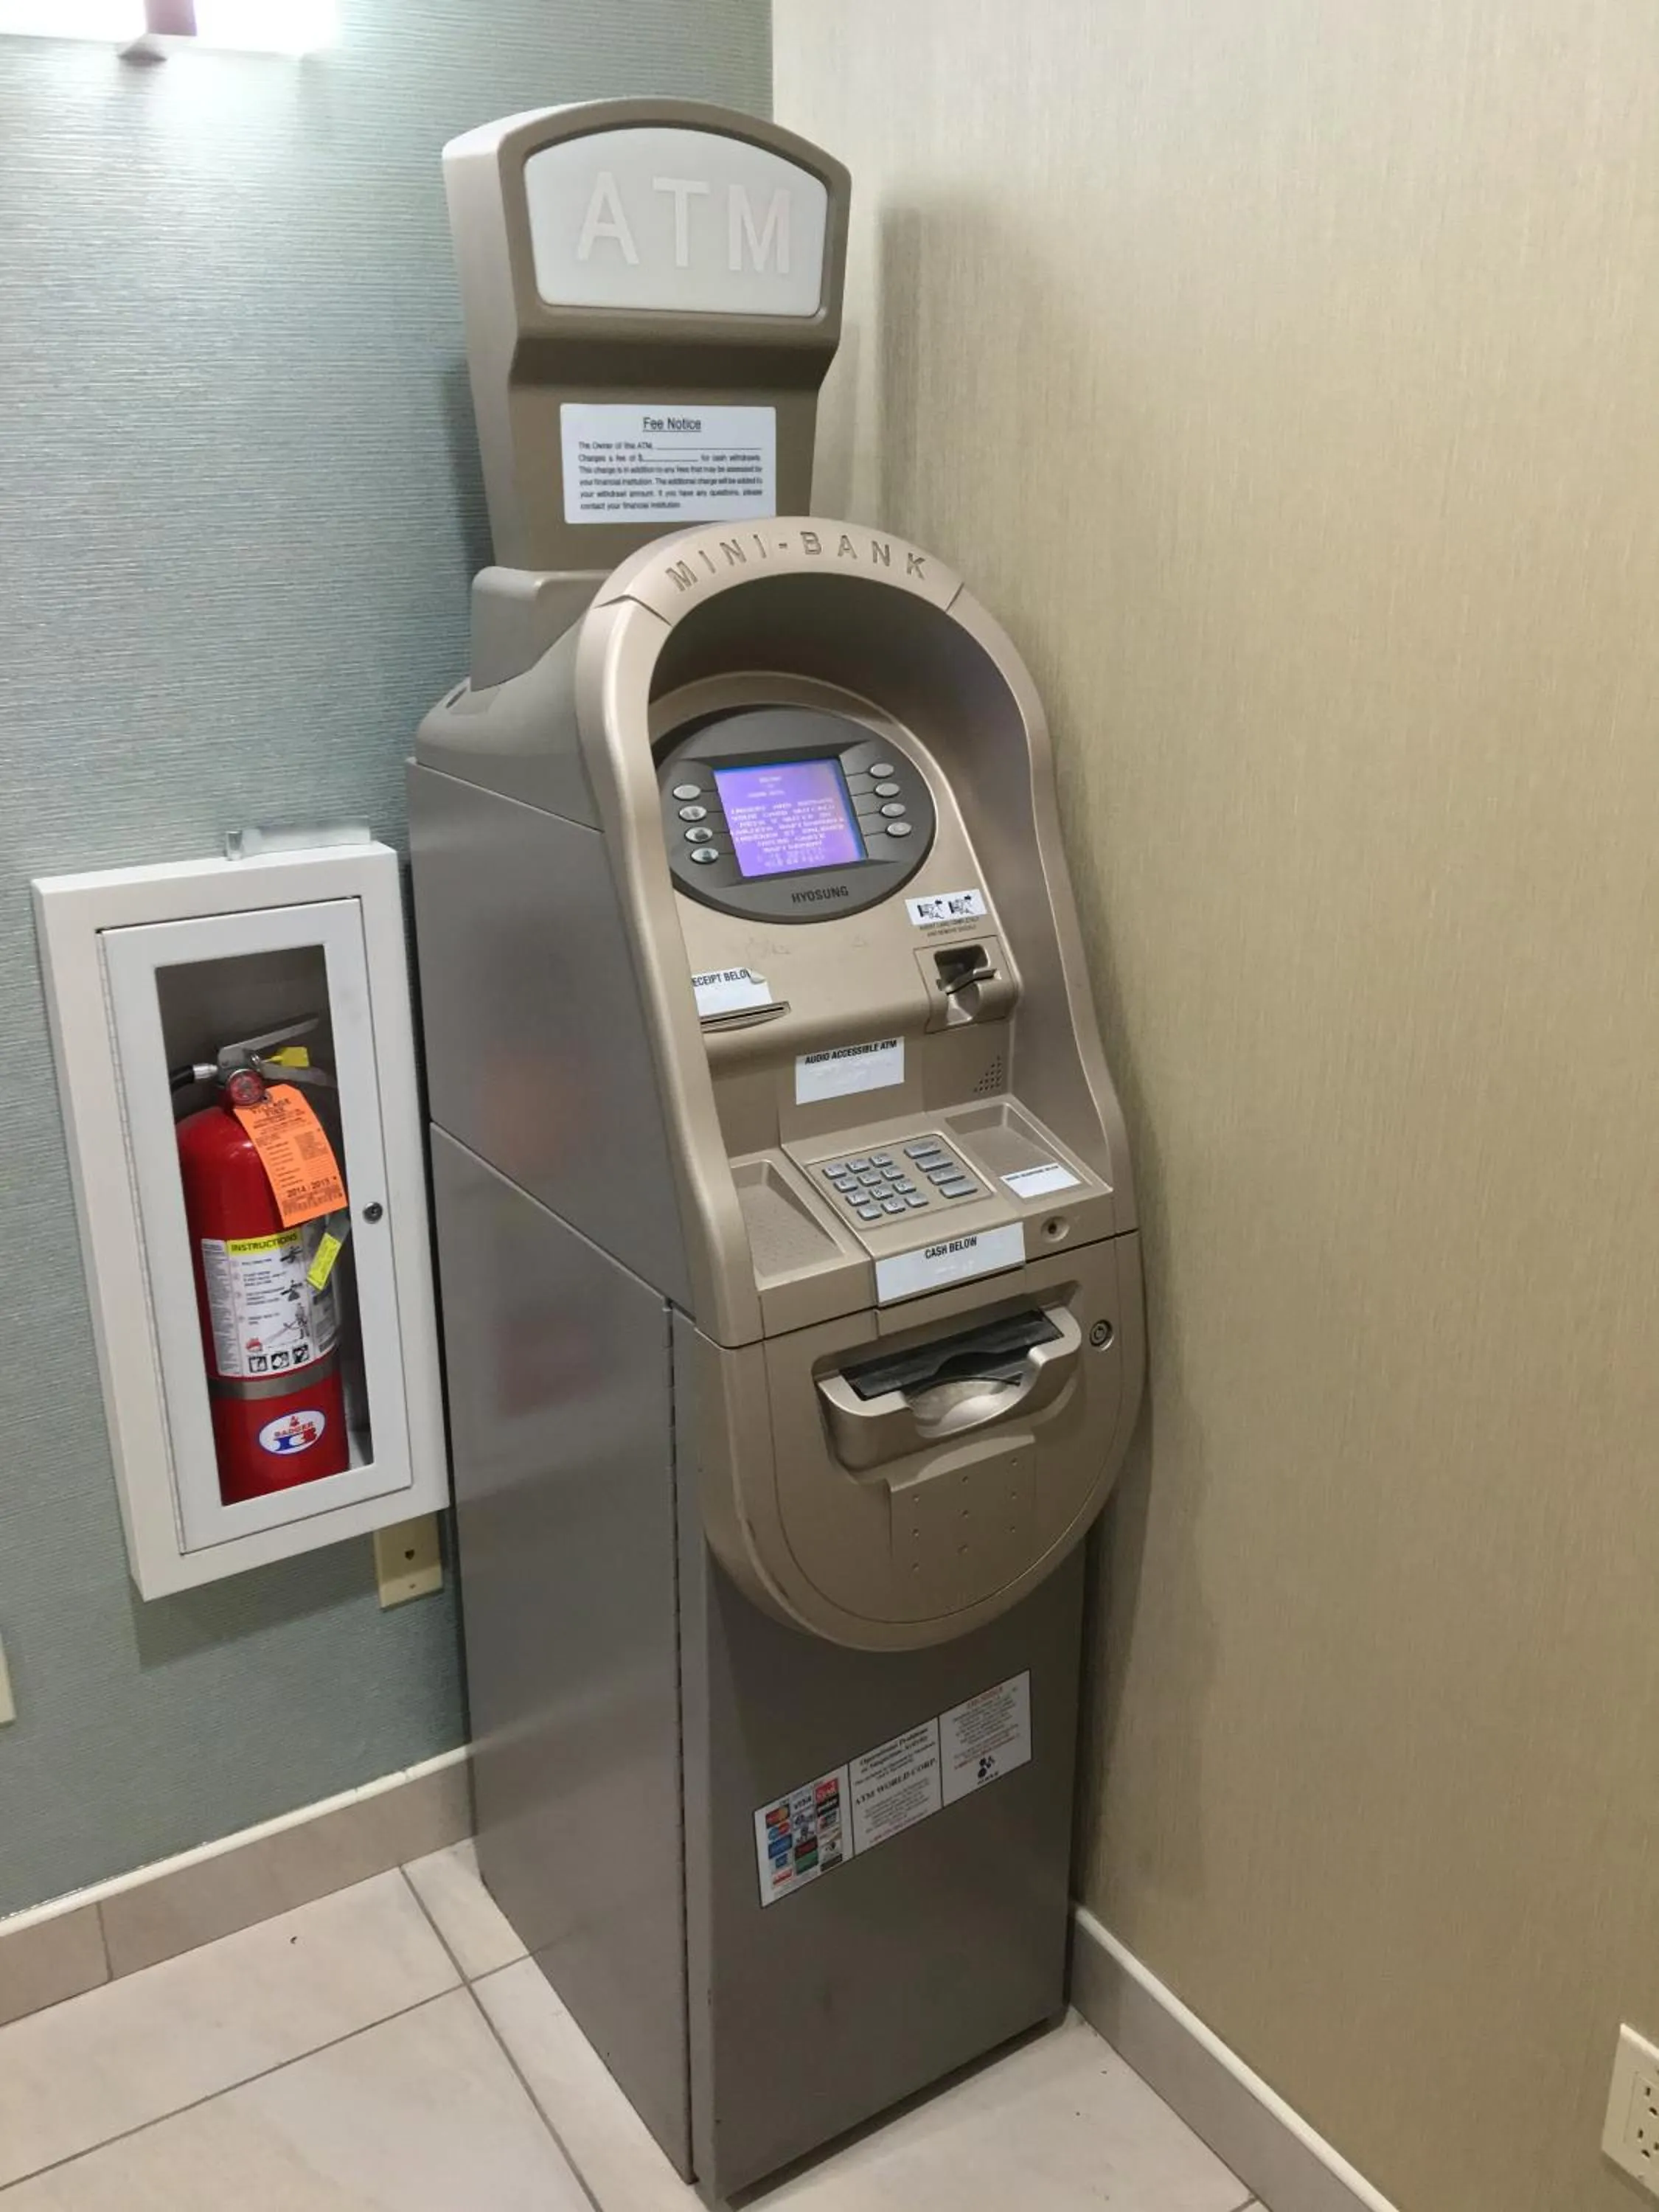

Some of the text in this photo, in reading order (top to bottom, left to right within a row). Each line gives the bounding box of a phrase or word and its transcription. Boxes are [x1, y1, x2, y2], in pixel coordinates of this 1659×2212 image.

[577, 171, 791, 274] ATM
[642, 416, 701, 430] Fee Notice
[791, 885, 849, 903] HYOSUNG
[691, 968, 751, 987] ECEIPT BELO
[804, 1039, 897, 1065] AUDIO ACCESSIBLE ATM
[231, 1233, 298, 1252] INSTRUCTIONS
[925, 1236, 977, 1259] CASH BELOW
